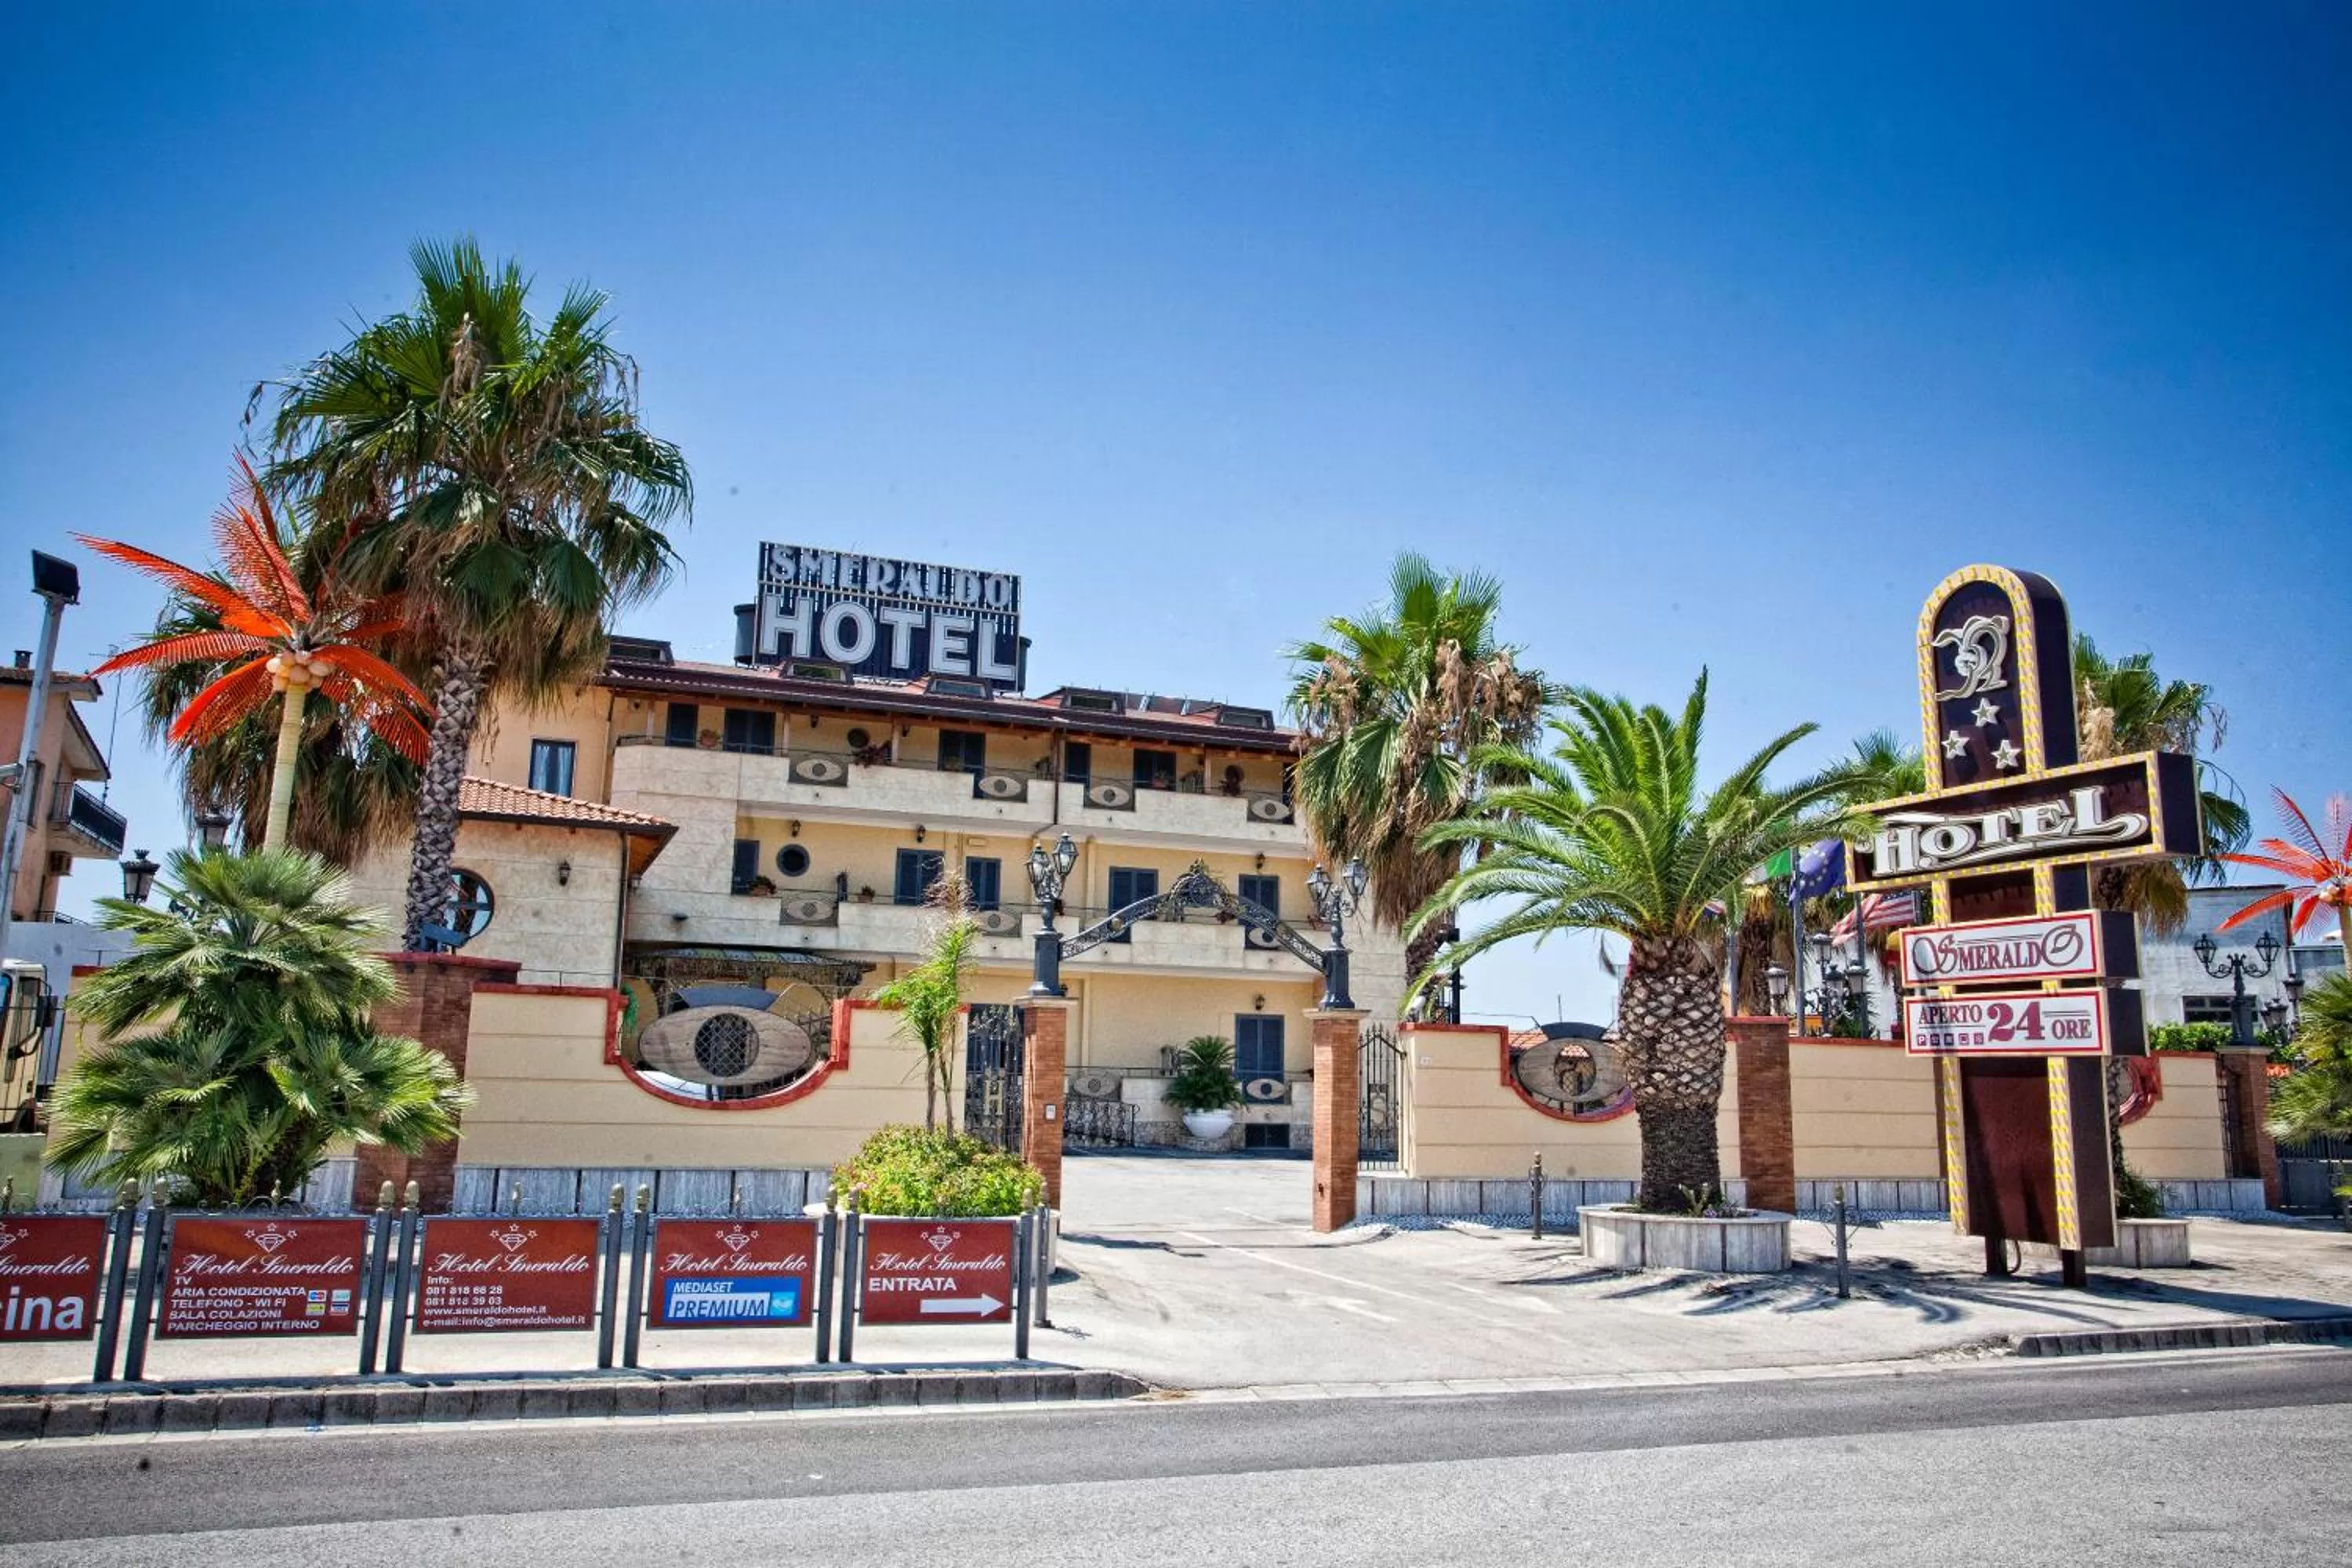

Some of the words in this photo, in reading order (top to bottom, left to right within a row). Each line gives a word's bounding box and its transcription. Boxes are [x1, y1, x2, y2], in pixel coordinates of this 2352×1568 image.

[769, 544, 1011, 608] SMERALDO
[759, 593, 1016, 681] HOTEL
[1855, 785, 2148, 877] HOTEL
[1919, 1004, 1983, 1025] APERTO
[1987, 1001, 2045, 1042] 24
[2052, 1018, 2092, 1040] ORE
[176, 1254, 257, 1274] Hotel
[252, 1254, 354, 1274] Smeraldo
[428, 1253, 503, 1272] Hotel
[497, 1254, 590, 1272] Smeraldo
[660, 1253, 731, 1272] Hotel
[724, 1253, 808, 1272] Smeraldo
[869, 1252, 934, 1271] Hotel
[928, 1253, 1007, 1272] Smeraldo
[176, 1276, 192, 1285] TV
[488, 1285, 503, 1294] 28
[673, 1281, 735, 1294] MEDIASET
[868, 1276, 958, 1292] ENTRATA
[172, 1287, 205, 1297] ARIA
[208, 1287, 307, 1296] CONDIZIONATA
[0, 1286, 84, 1330] ina
[171, 1299, 244, 1308] TELEFONO
[255, 1298, 271, 1307] WI
[673, 1299, 766, 1318] PREMIUM
[169, 1310, 205, 1319] SALA
[209, 1309, 281, 1319] COLAZIONI
[168, 1321, 258, 1331] PARCHEGGIO
[261, 1319, 320, 1330] INTERNO
